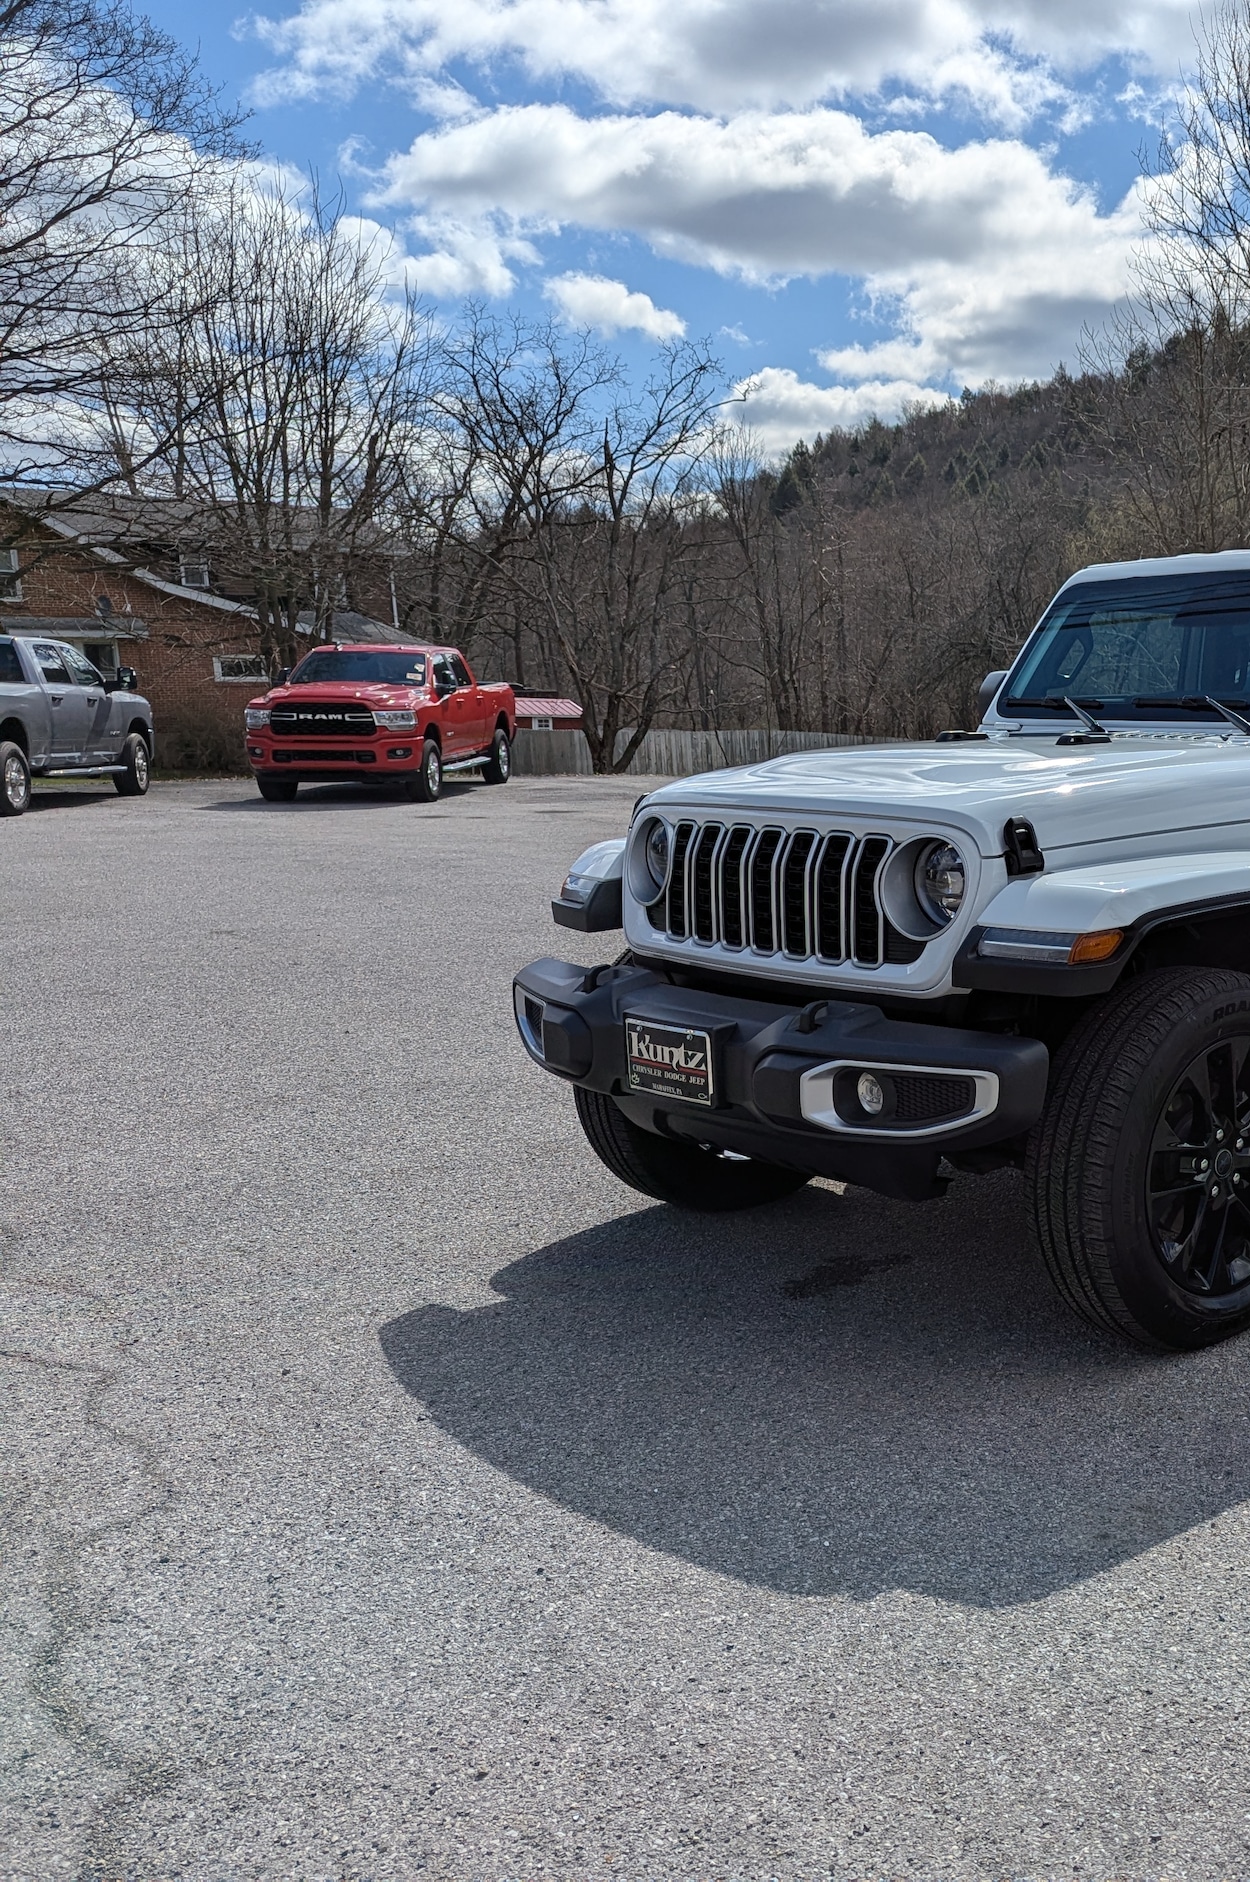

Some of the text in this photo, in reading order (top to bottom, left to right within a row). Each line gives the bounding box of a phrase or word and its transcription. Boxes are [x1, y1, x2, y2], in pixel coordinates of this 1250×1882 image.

[628, 1031, 707, 1071] Kuntz
[632, 1064, 706, 1086] CHRYSLER DODGE JEEP
